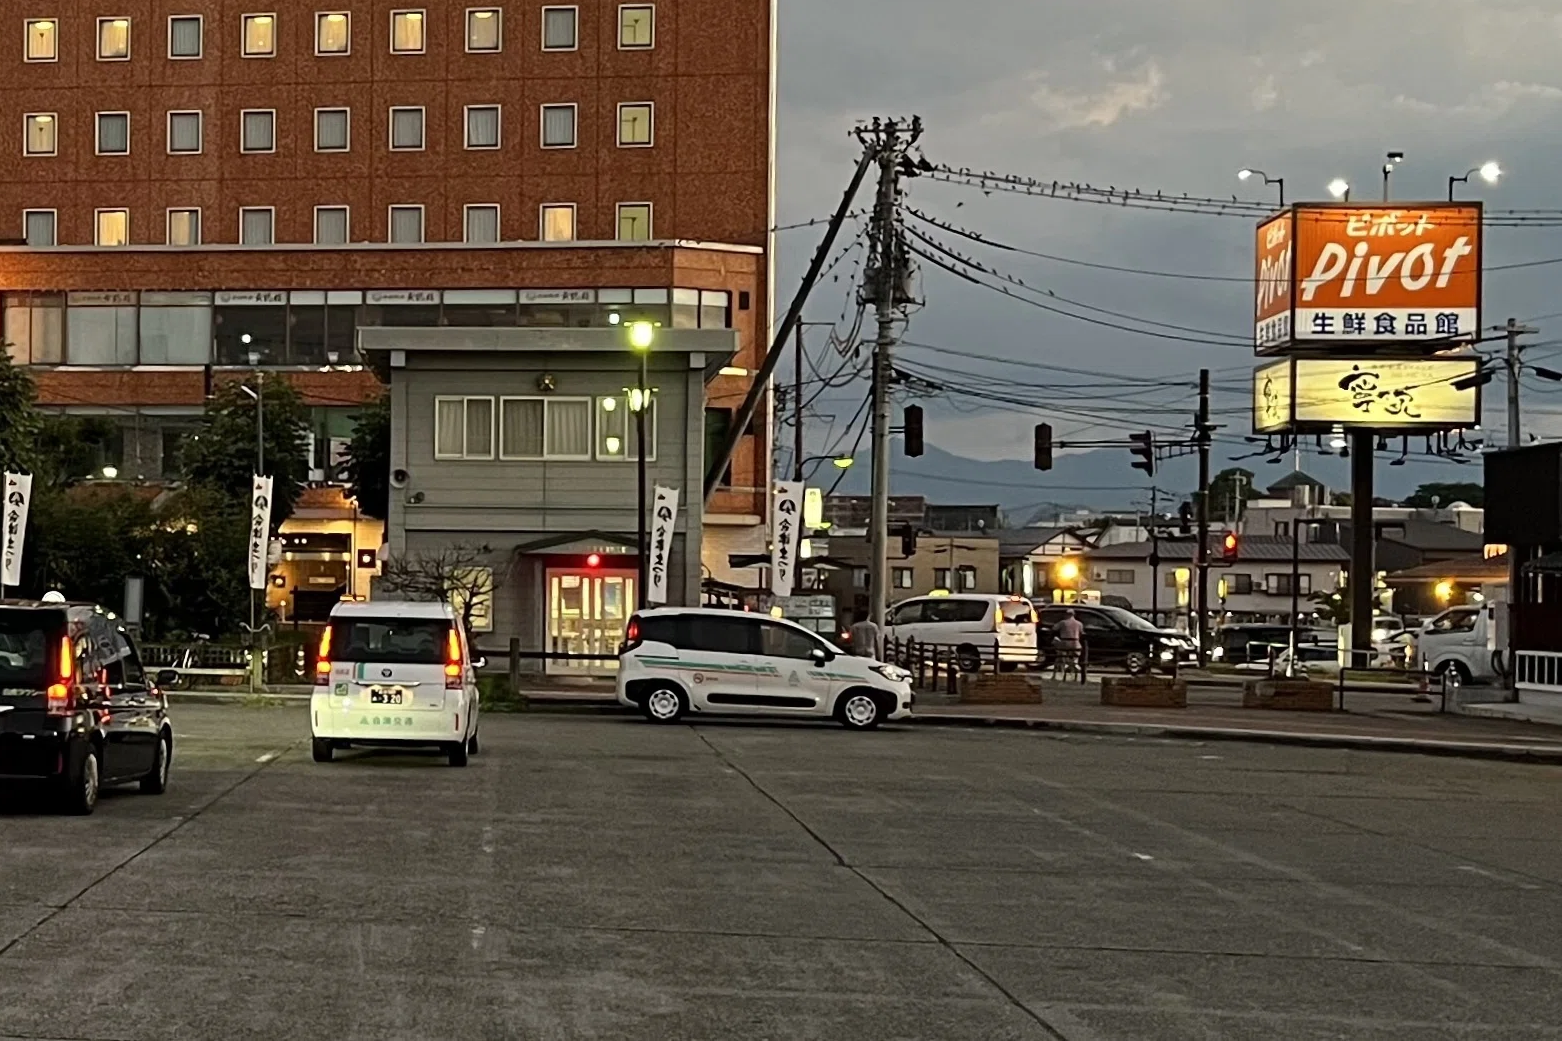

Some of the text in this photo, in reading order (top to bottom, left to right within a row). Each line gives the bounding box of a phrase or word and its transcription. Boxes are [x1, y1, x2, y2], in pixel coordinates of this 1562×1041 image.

[1346, 213, 1435, 237] ピポット
[1300, 236, 1473, 302] Pivot
[1311, 311, 1460, 336] 生鮮食品館
